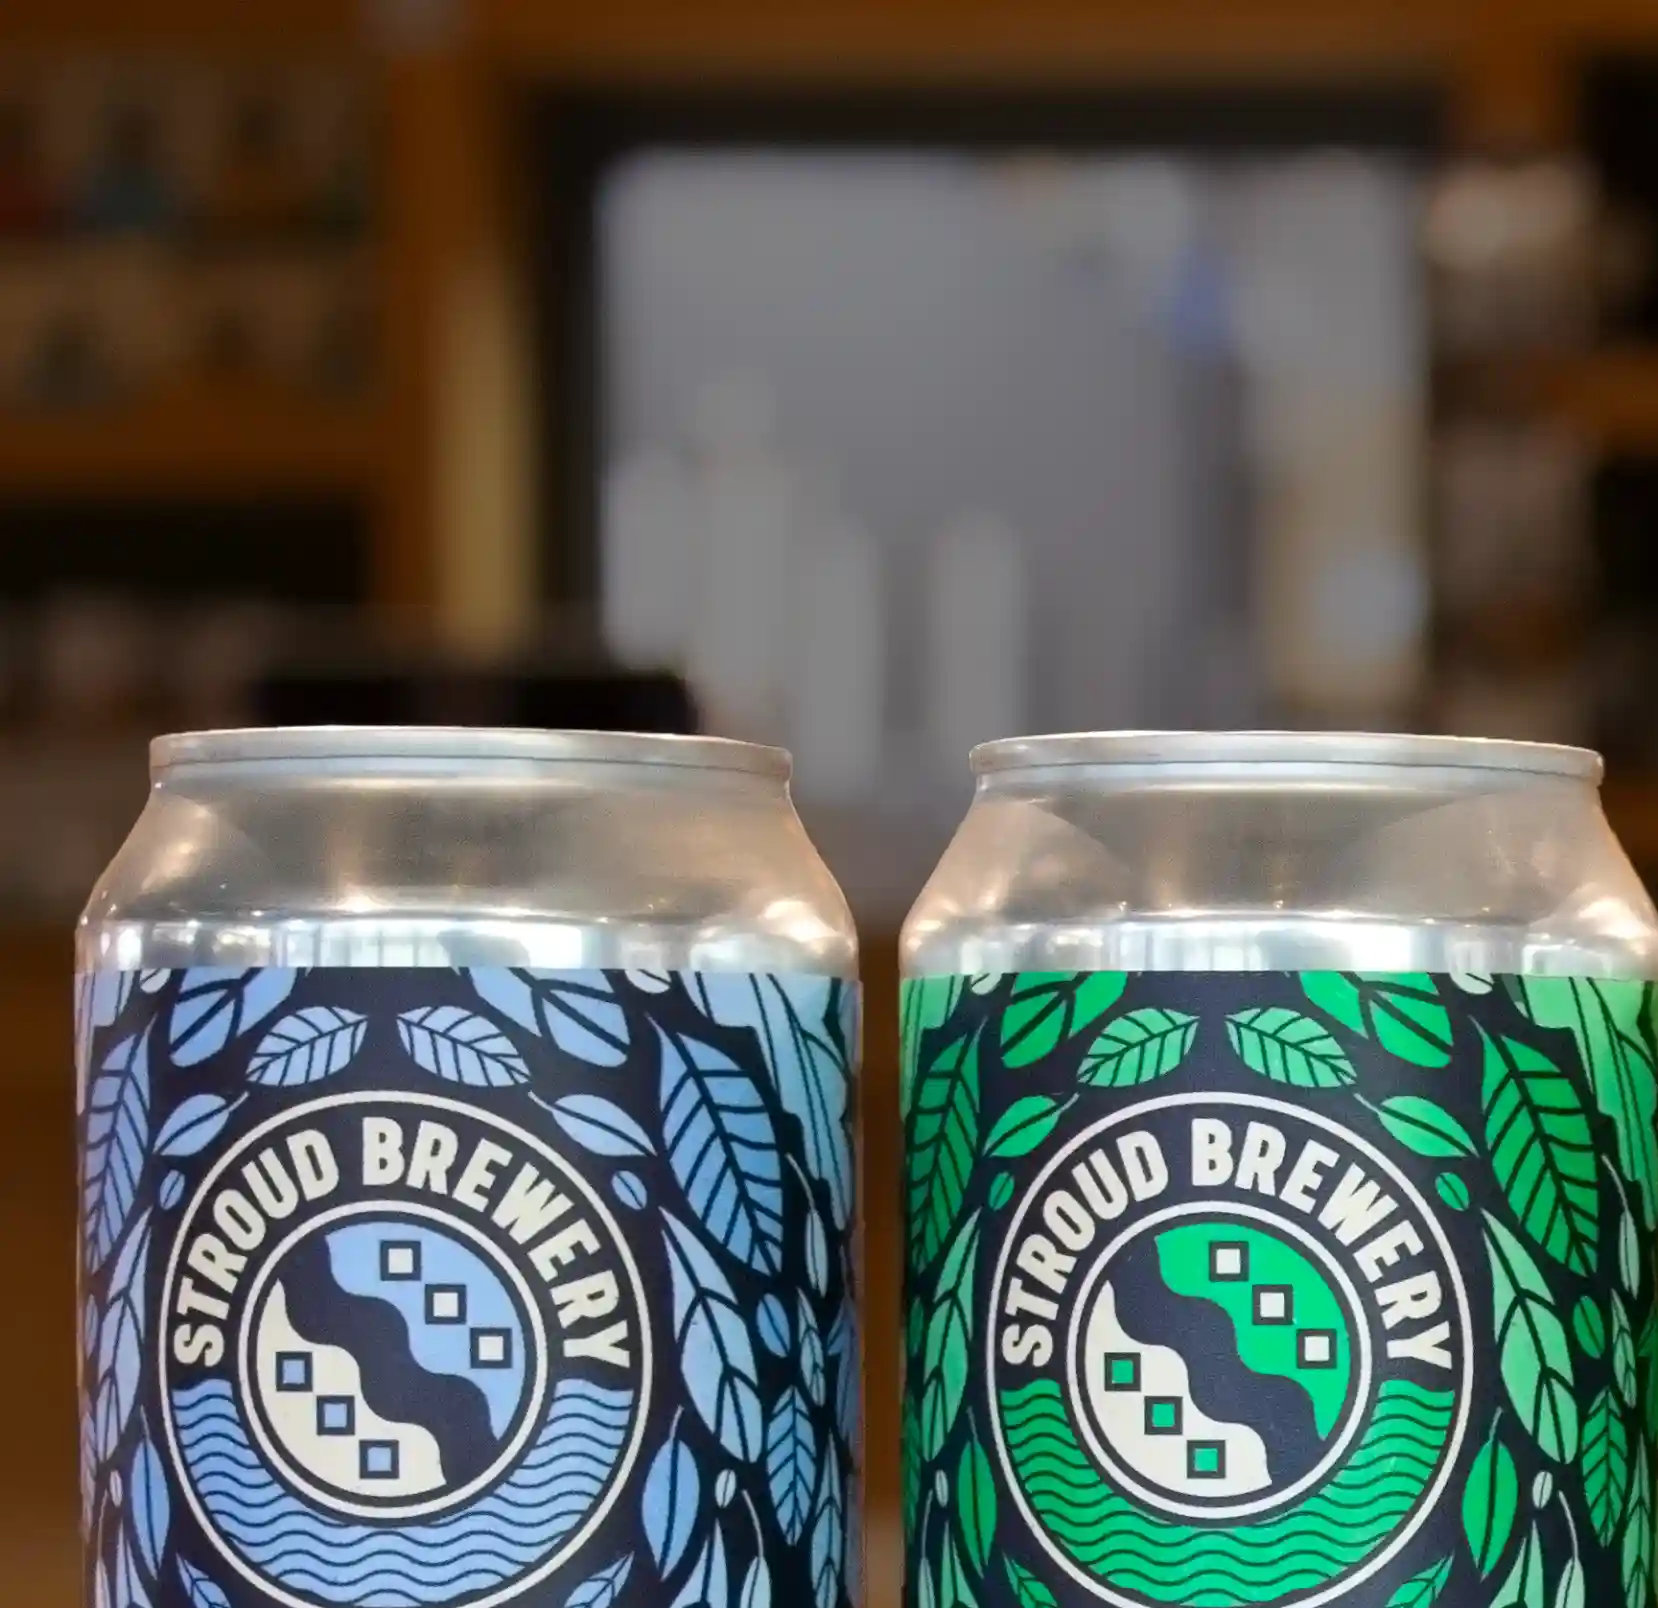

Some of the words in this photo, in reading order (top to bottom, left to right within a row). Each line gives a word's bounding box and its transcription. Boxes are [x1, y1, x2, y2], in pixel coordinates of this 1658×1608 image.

[173, 1129, 340, 1367] STROUD
[362, 1116, 630, 1368] BREWERY
[1000, 1130, 1169, 1367] STROUD
[1191, 1117, 1455, 1370] BREWERY
